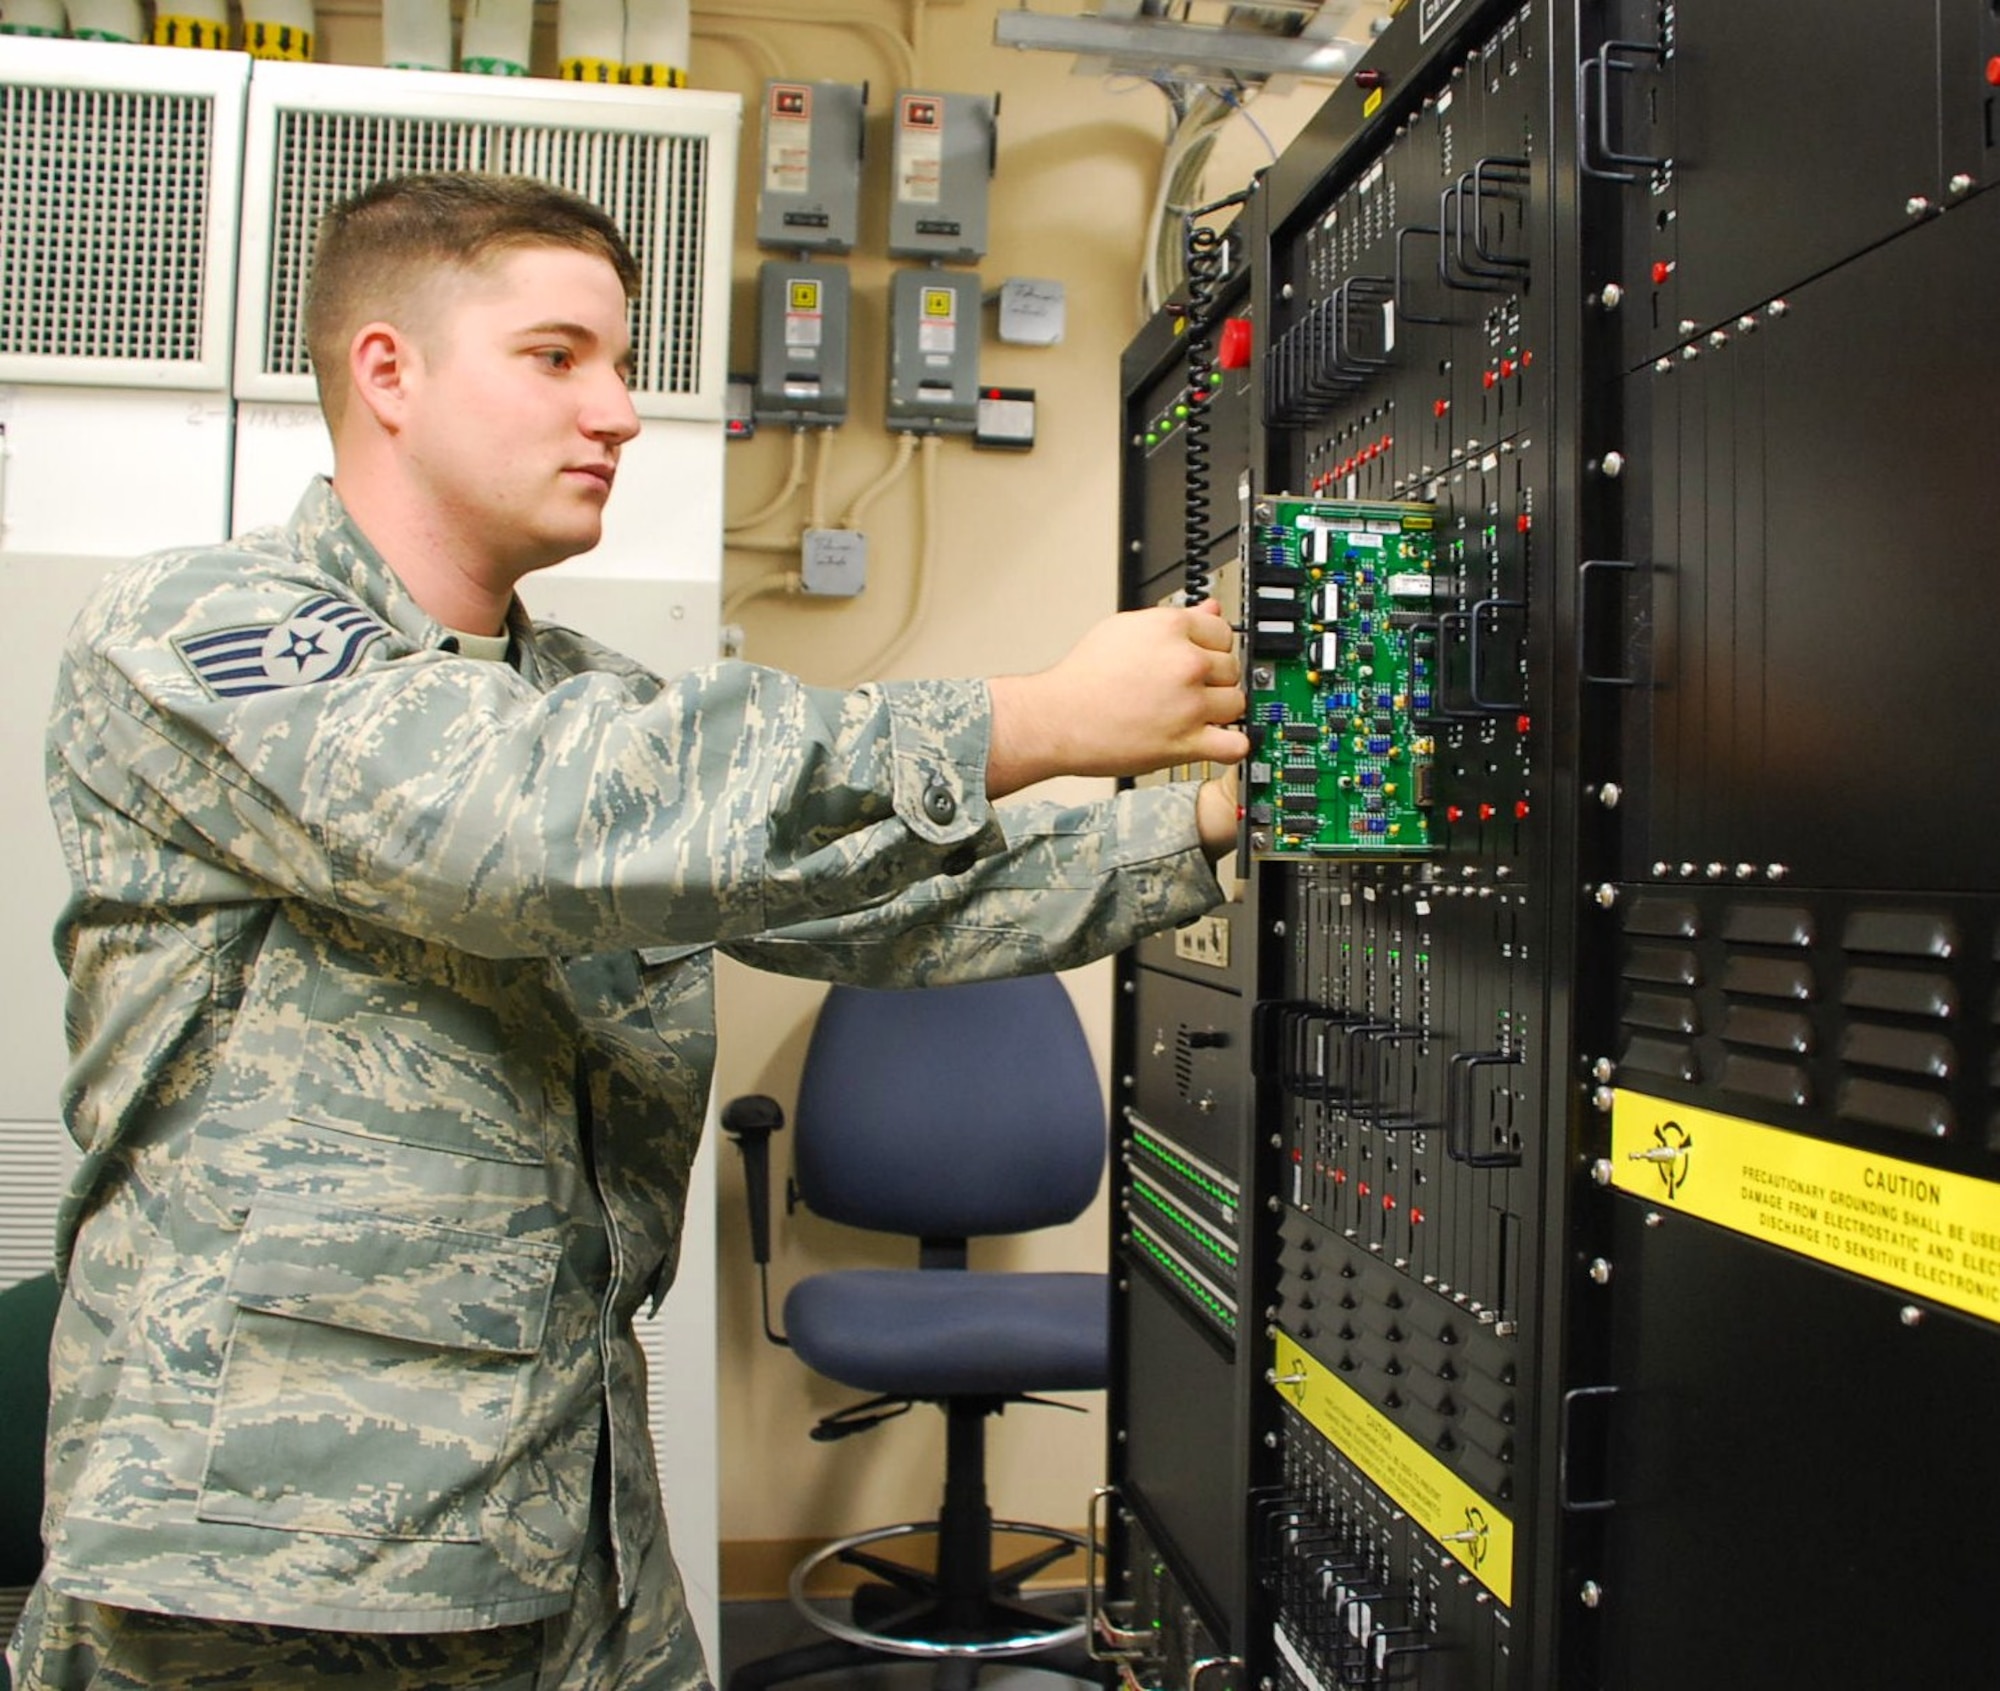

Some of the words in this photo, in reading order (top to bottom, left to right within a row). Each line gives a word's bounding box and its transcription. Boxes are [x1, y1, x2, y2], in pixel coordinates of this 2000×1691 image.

[1742, 1165, 1825, 1200] PRECAUTIONARY
[1830, 1189, 1898, 1222] GROUNDING
[1903, 1210, 1941, 1236] SHALL
[1949, 1223, 1964, 1243] BE
[1864, 1167, 1940, 1206] CAUTION
[1741, 1186, 1782, 1211] DAMAGE
[1788, 1200, 1818, 1220] FROM
[1824, 1210, 1919, 1253] ELECTROSTATIC
[1928, 1243, 1955, 1263] AND
[1760, 1212, 1820, 1244] DISCHARGE
[1825, 1233, 1841, 1251] TO
[1845, 1239, 1908, 1273] SENSITIVE
